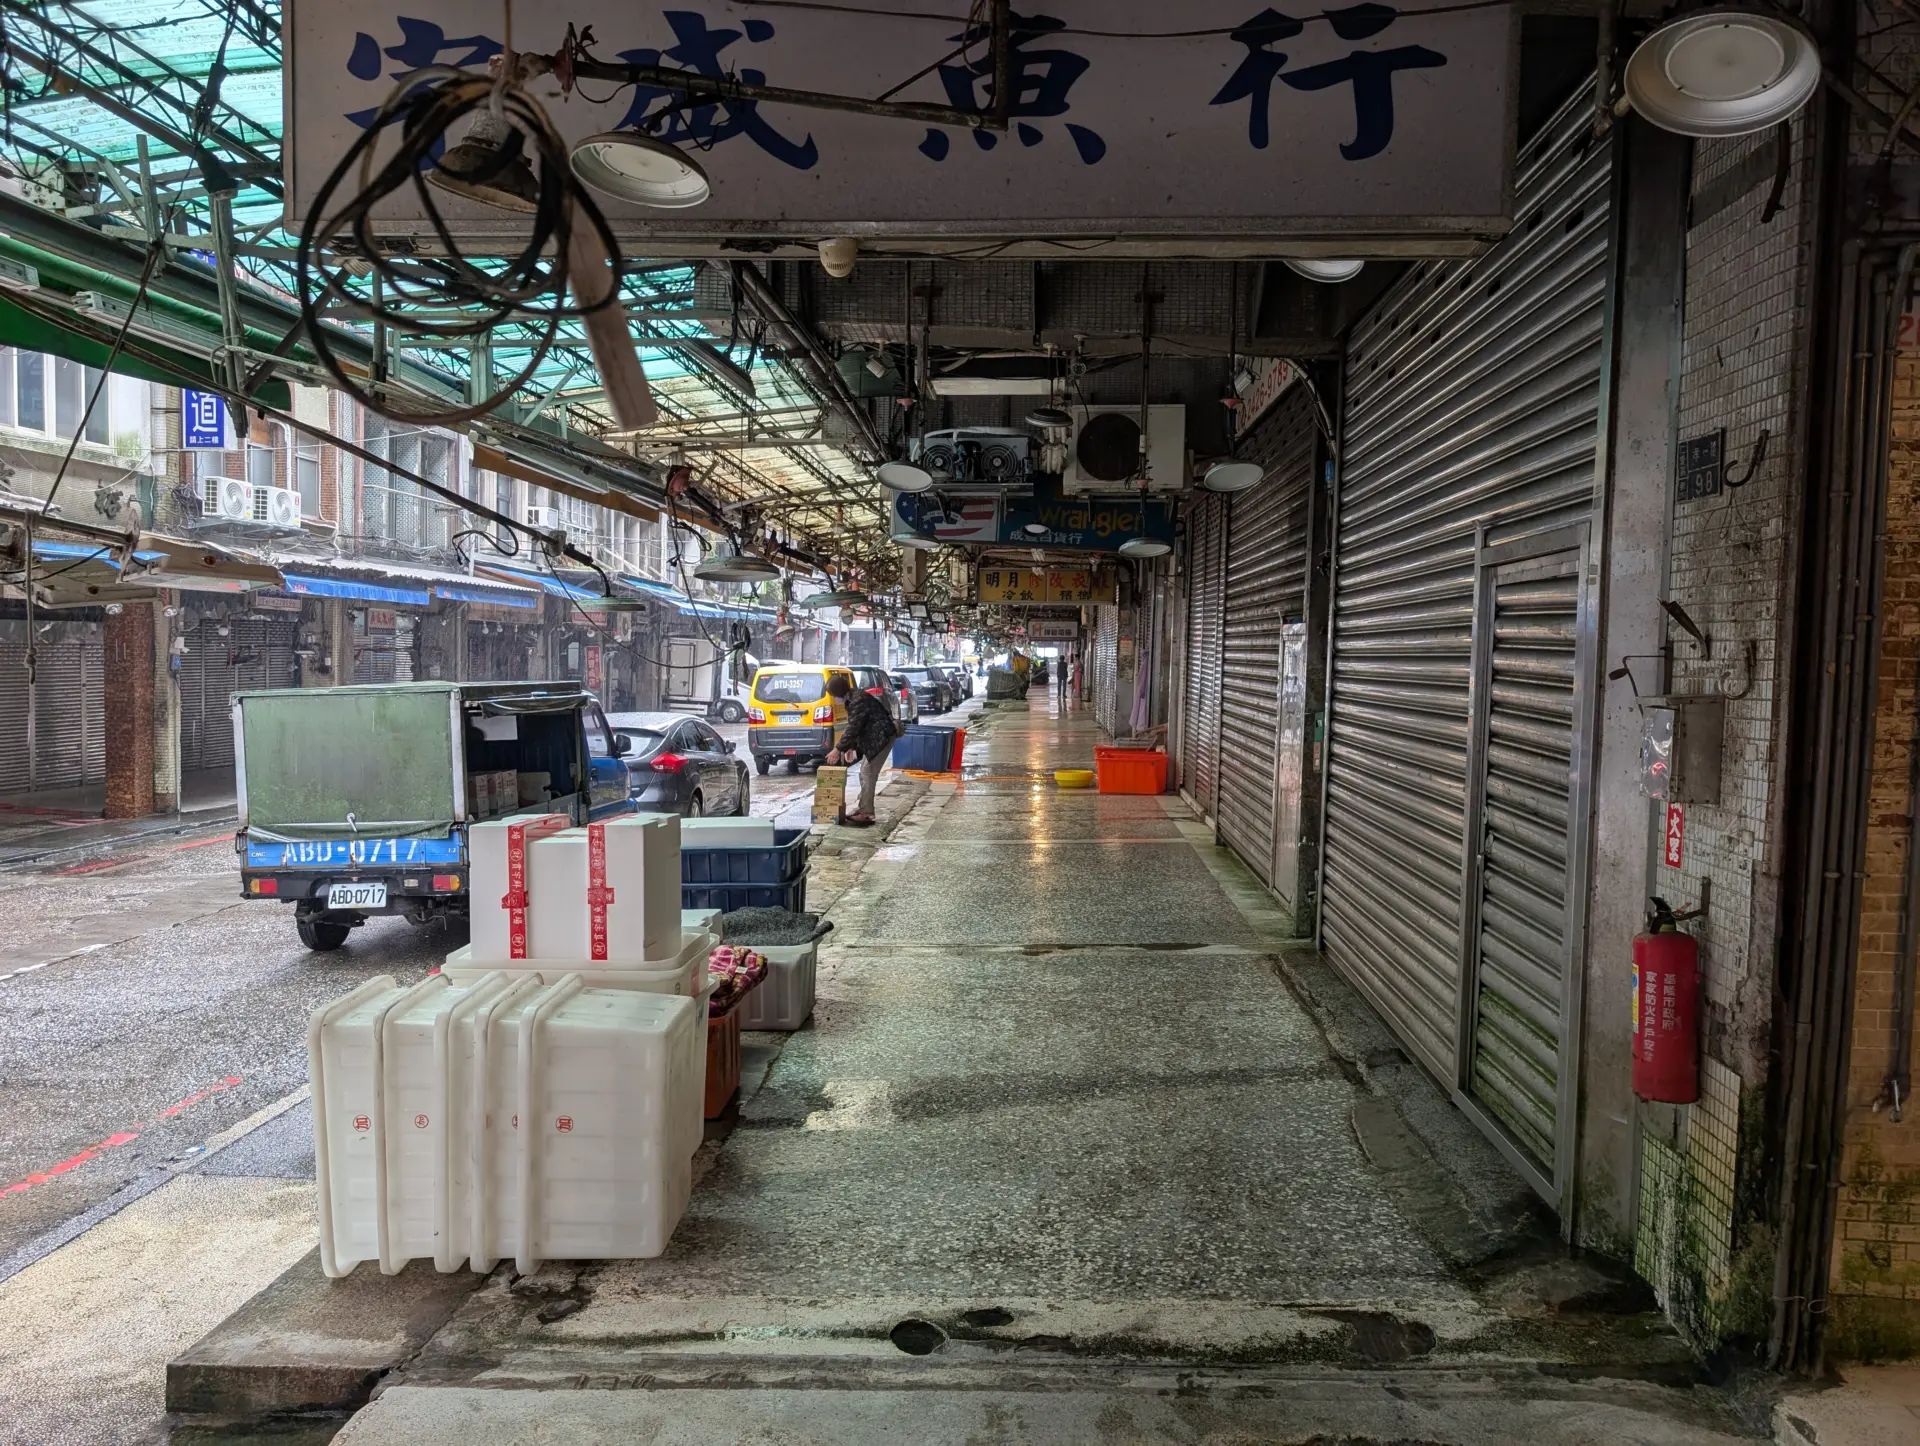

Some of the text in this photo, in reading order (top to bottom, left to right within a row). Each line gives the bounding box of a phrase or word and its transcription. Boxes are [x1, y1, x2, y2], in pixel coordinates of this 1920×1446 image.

[1695, 470, 1713, 495] 98
[774, 679, 804, 689] BTU-3257
[330, 888, 385, 905] ABD-0717
[1661, 973, 1676, 1031] 基隆市政府
[1643, 971, 1657, 1062] 家家防火戶戶安全
